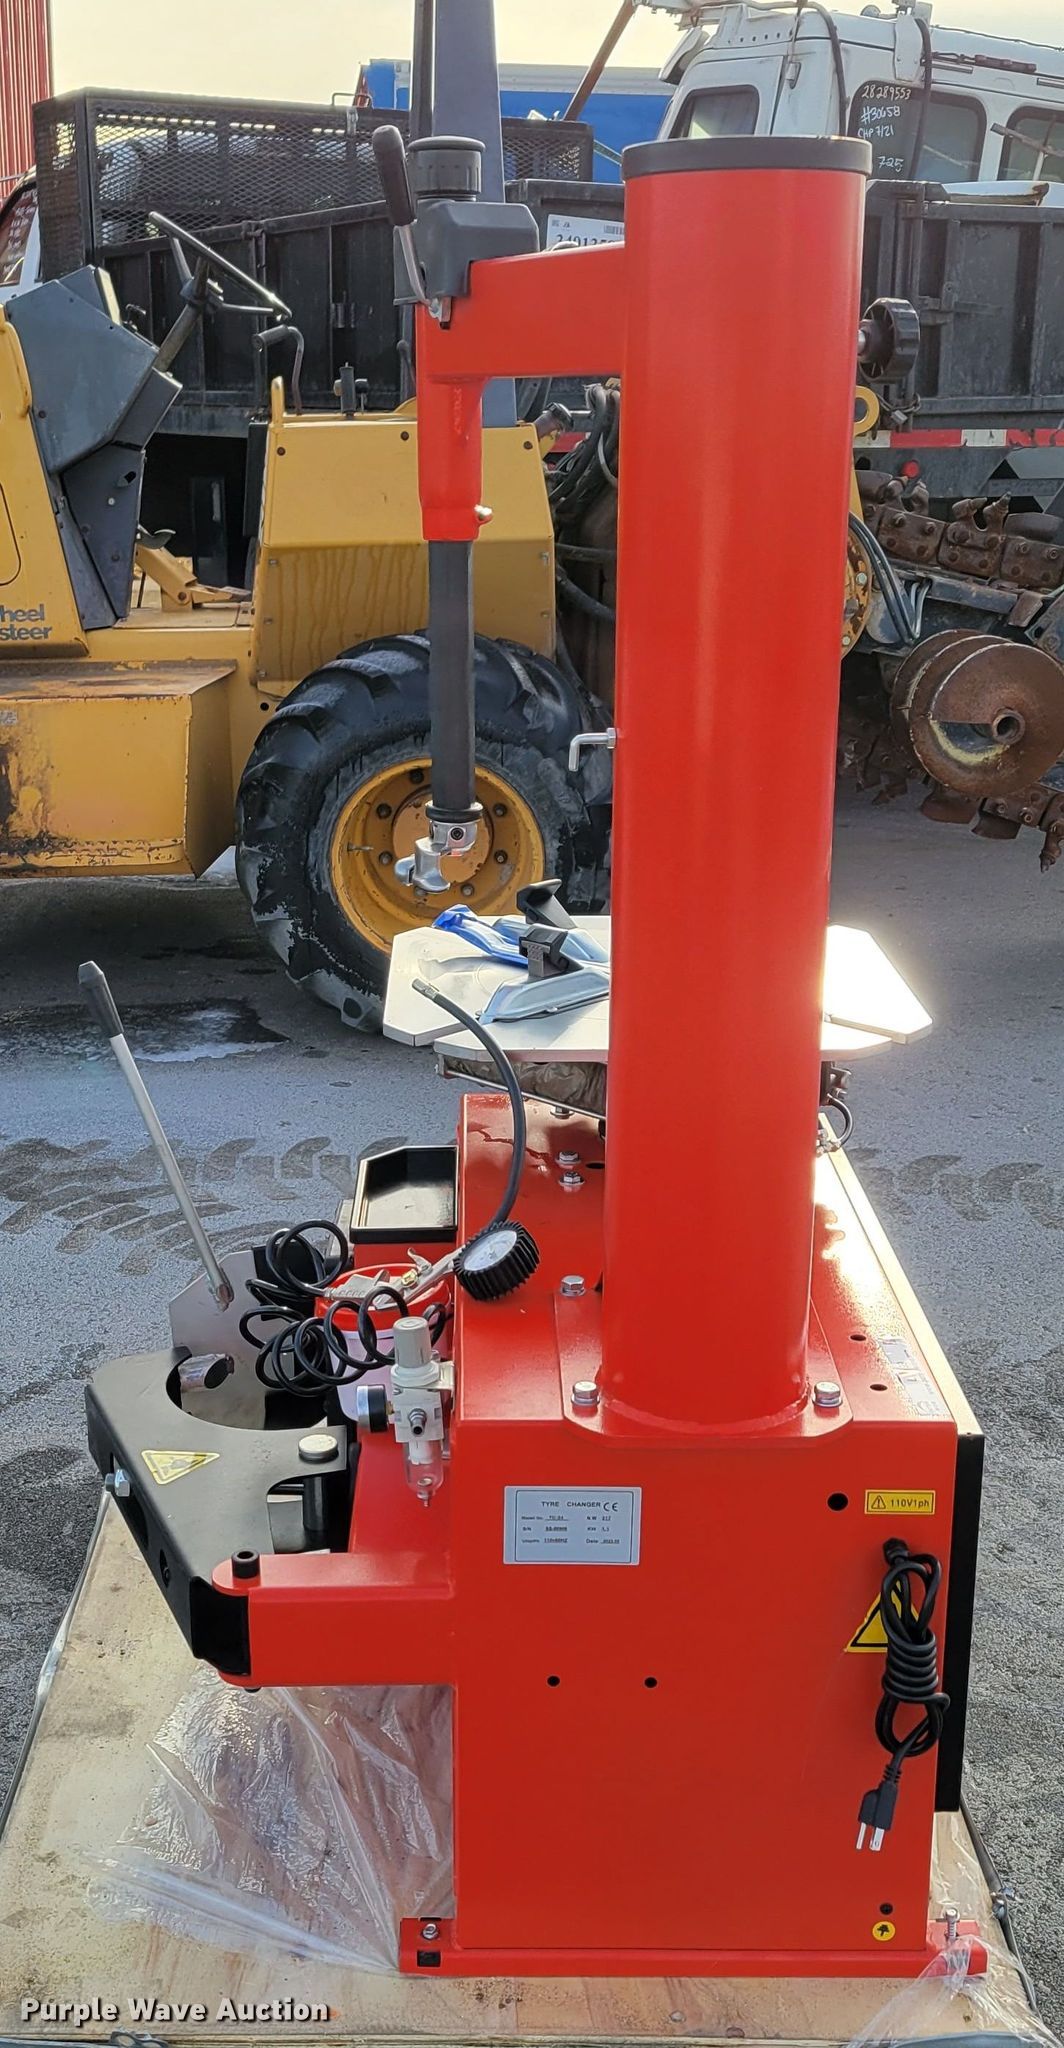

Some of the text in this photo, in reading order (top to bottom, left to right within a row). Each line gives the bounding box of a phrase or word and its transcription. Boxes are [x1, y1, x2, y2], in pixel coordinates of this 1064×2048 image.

[862, 84, 911, 101] 28289553
[878, 155, 904, 172] 725
[0, 624, 53, 640] steer
[890, 1498, 930, 1509] 110V1ph
